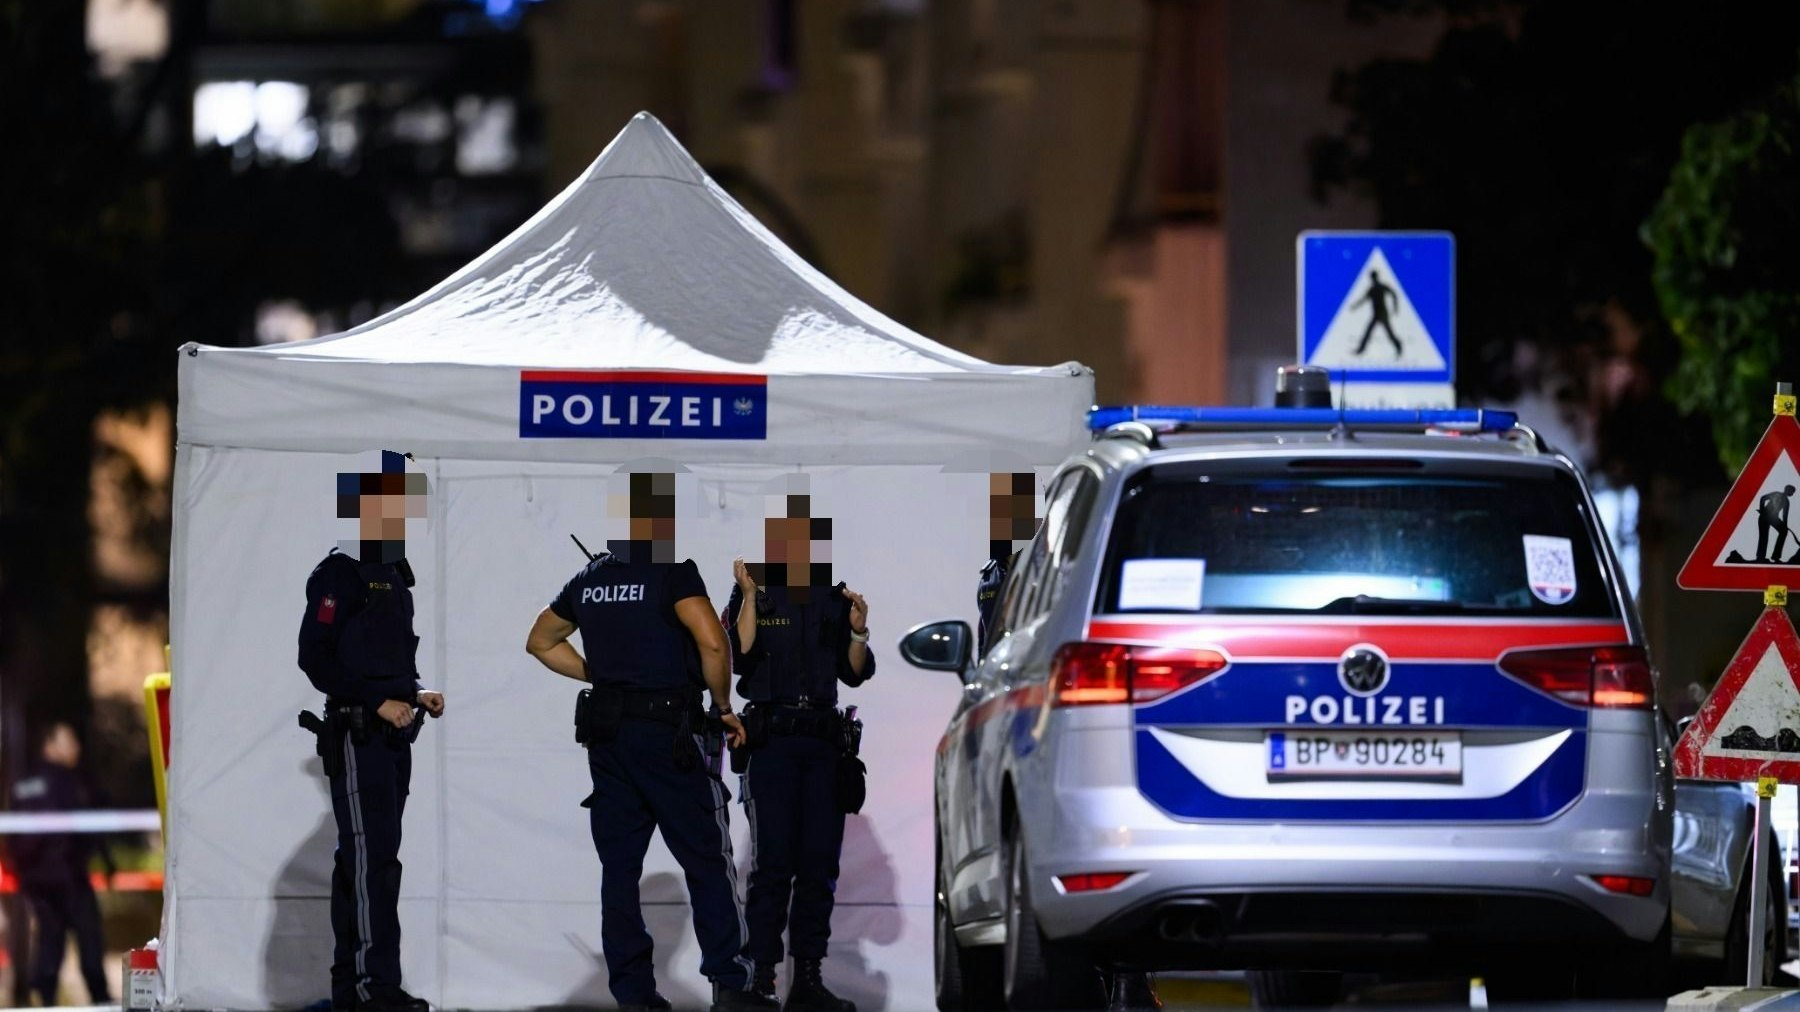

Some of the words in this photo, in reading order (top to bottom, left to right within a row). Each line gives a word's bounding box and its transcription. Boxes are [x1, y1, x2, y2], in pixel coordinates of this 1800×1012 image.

[532, 394, 722, 427] POLIZEI
[581, 584, 645, 604] POLIZEI
[1285, 694, 1445, 725] POLIZEI
[1296, 737, 1330, 765] BP
[1355, 737, 1444, 765] 90284
